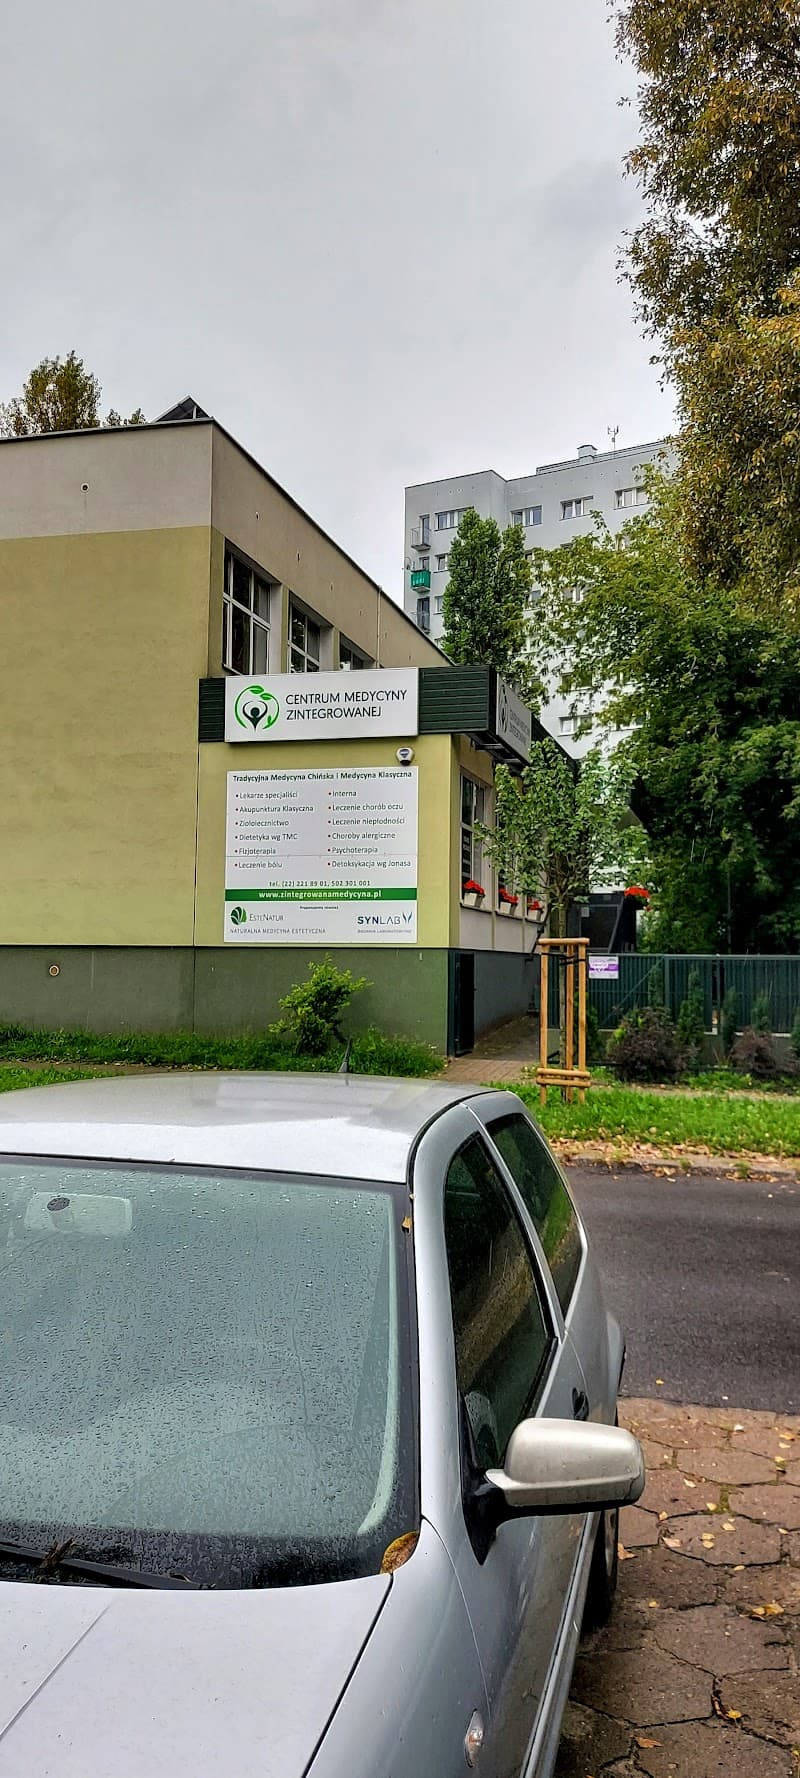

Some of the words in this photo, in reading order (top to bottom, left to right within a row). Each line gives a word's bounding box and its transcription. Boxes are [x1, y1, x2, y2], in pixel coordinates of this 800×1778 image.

[285, 692, 340, 705] CENTRUM
[344, 689, 407, 703] MEDYCYNY
[286, 706, 381, 721] ZINTEGROWANEJ
[233, 774, 269, 782] Tradycyjna
[307, 772, 334, 780] Chińska
[340, 772, 376, 780] Medycyna
[378, 771, 412, 779] Klasyczna
[265, 791, 298, 799] specjaliści
[240, 806, 281, 814] Akupunktura
[282, 805, 314, 813] Klasyczna
[362, 817, 405, 825] niepłodności
[361, 832, 396, 840] alergiczne
[332, 860, 375, 868] Detoksykacja
[259, 890, 382, 899] www.zintegrowanamedycyna.pl
[357, 915, 401, 925] SYNLAB
